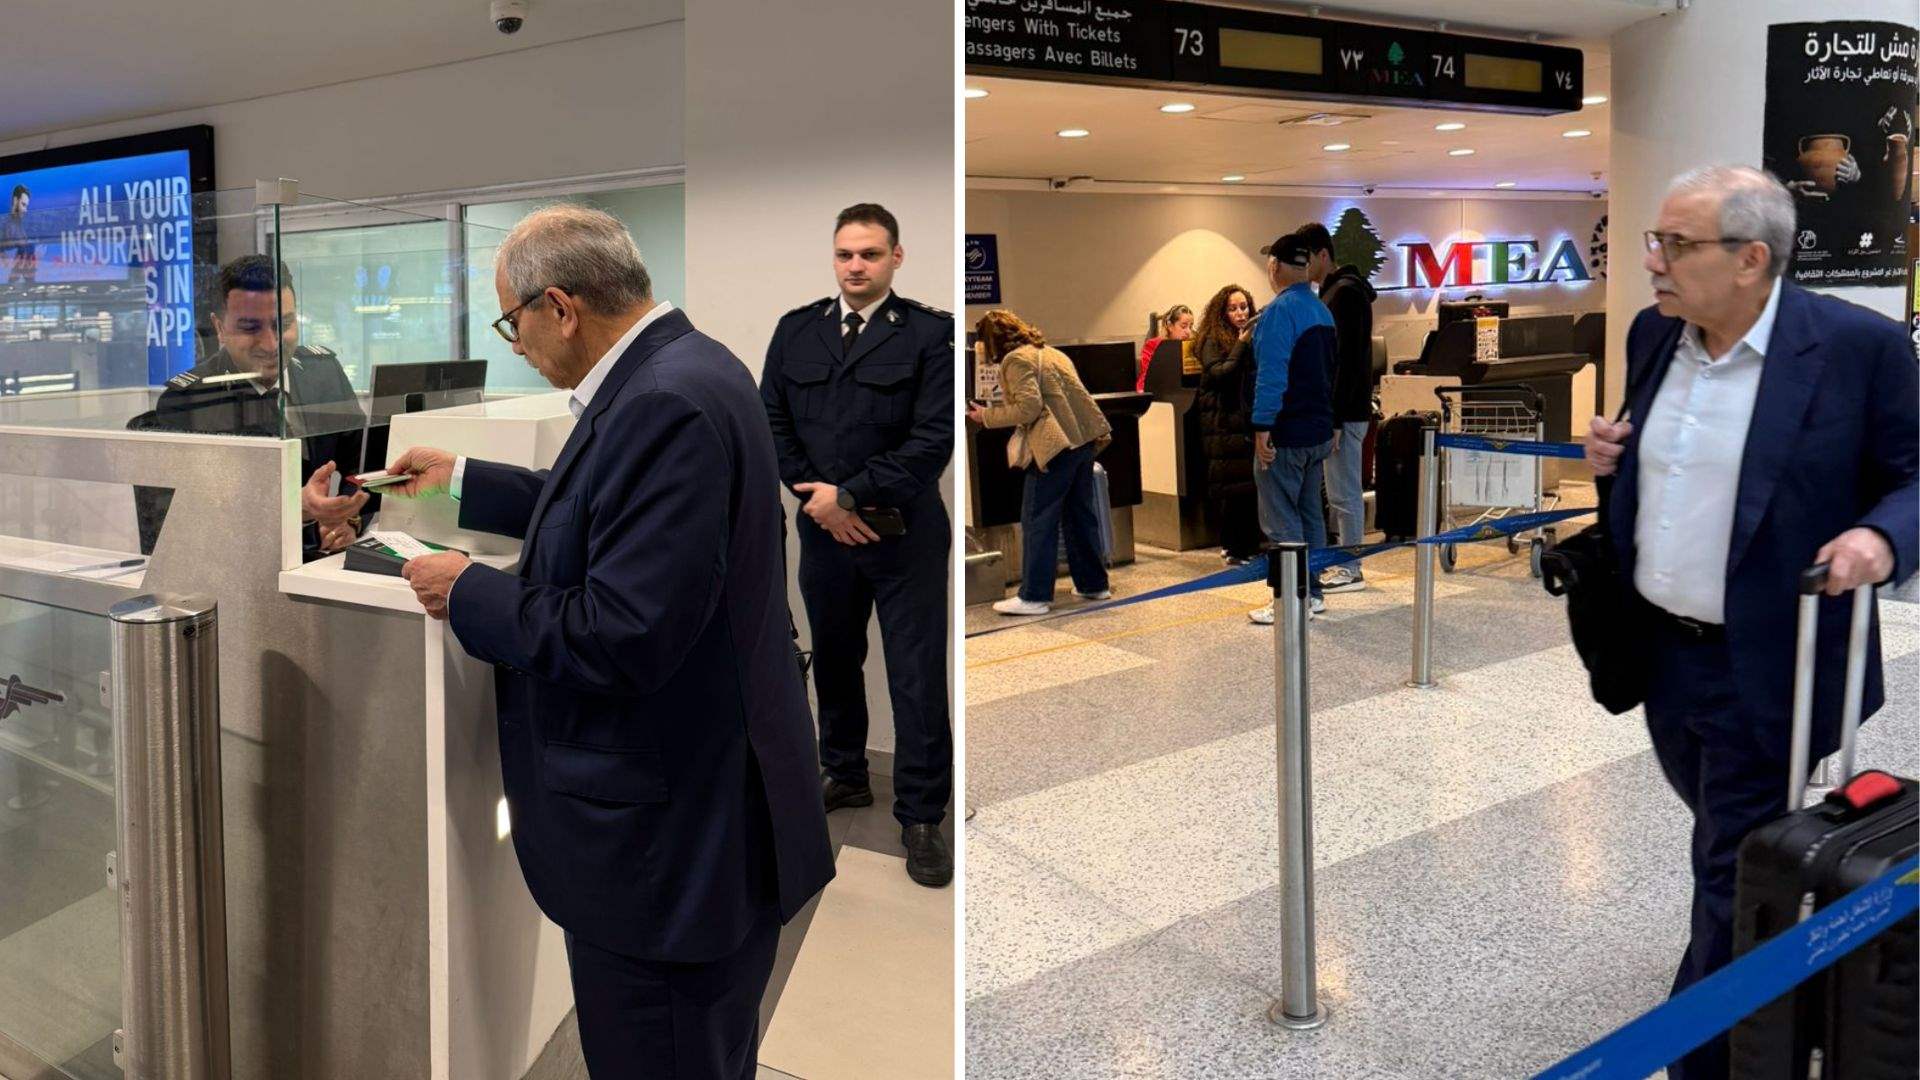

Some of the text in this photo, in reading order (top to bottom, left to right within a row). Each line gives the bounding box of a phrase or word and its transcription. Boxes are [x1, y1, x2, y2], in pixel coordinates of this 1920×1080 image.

[1094, 7, 1133, 22] جميع
[1024, 17, 1060, 38] With
[1067, 22, 1121, 44] Tickets
[1174, 27, 1205, 57] 73
[966, 41, 1138, 70] assagers Avec Billets
[1340, 48, 1364, 71] ٧٣
[1804, 31, 1876, 62] للتجارة
[1880, 31, 1910, 62] مش
[1368, 67, 1424, 87] MEA
[1432, 54, 1455, 79] 74
[1555, 69, 1574, 91] ٧٤
[1833, 66, 1862, 82] تجارة
[78, 176, 190, 226] ALL YOUR
[60, 220, 191, 265] INSURANCE
[1396, 239, 1596, 290] MEA
[166, 264, 191, 304] IN
[147, 307, 192, 348] APP
